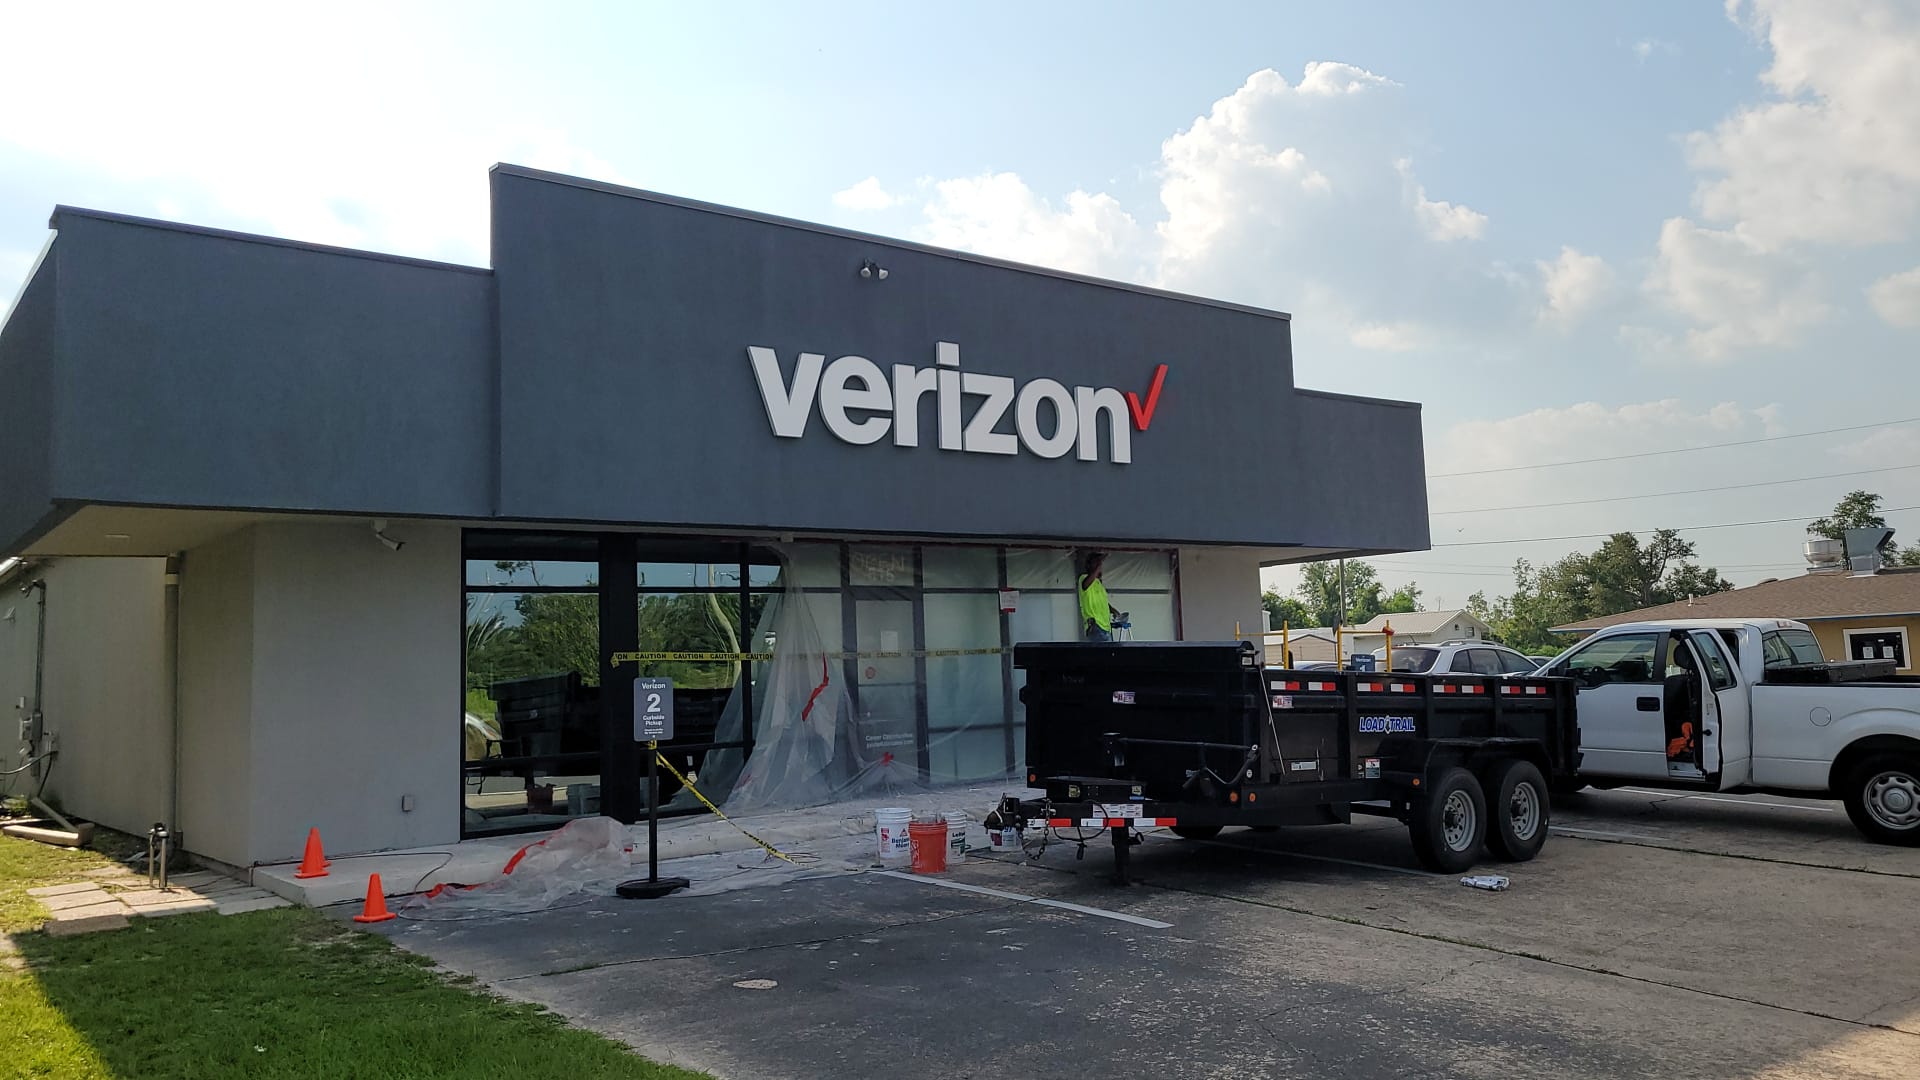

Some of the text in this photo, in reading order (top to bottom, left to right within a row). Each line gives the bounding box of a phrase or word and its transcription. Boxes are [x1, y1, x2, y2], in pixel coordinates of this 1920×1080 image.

[747, 341, 1132, 464] verizon
[646, 693, 661, 713] 2
[1359, 716, 1416, 732] LOAD TRAIL
